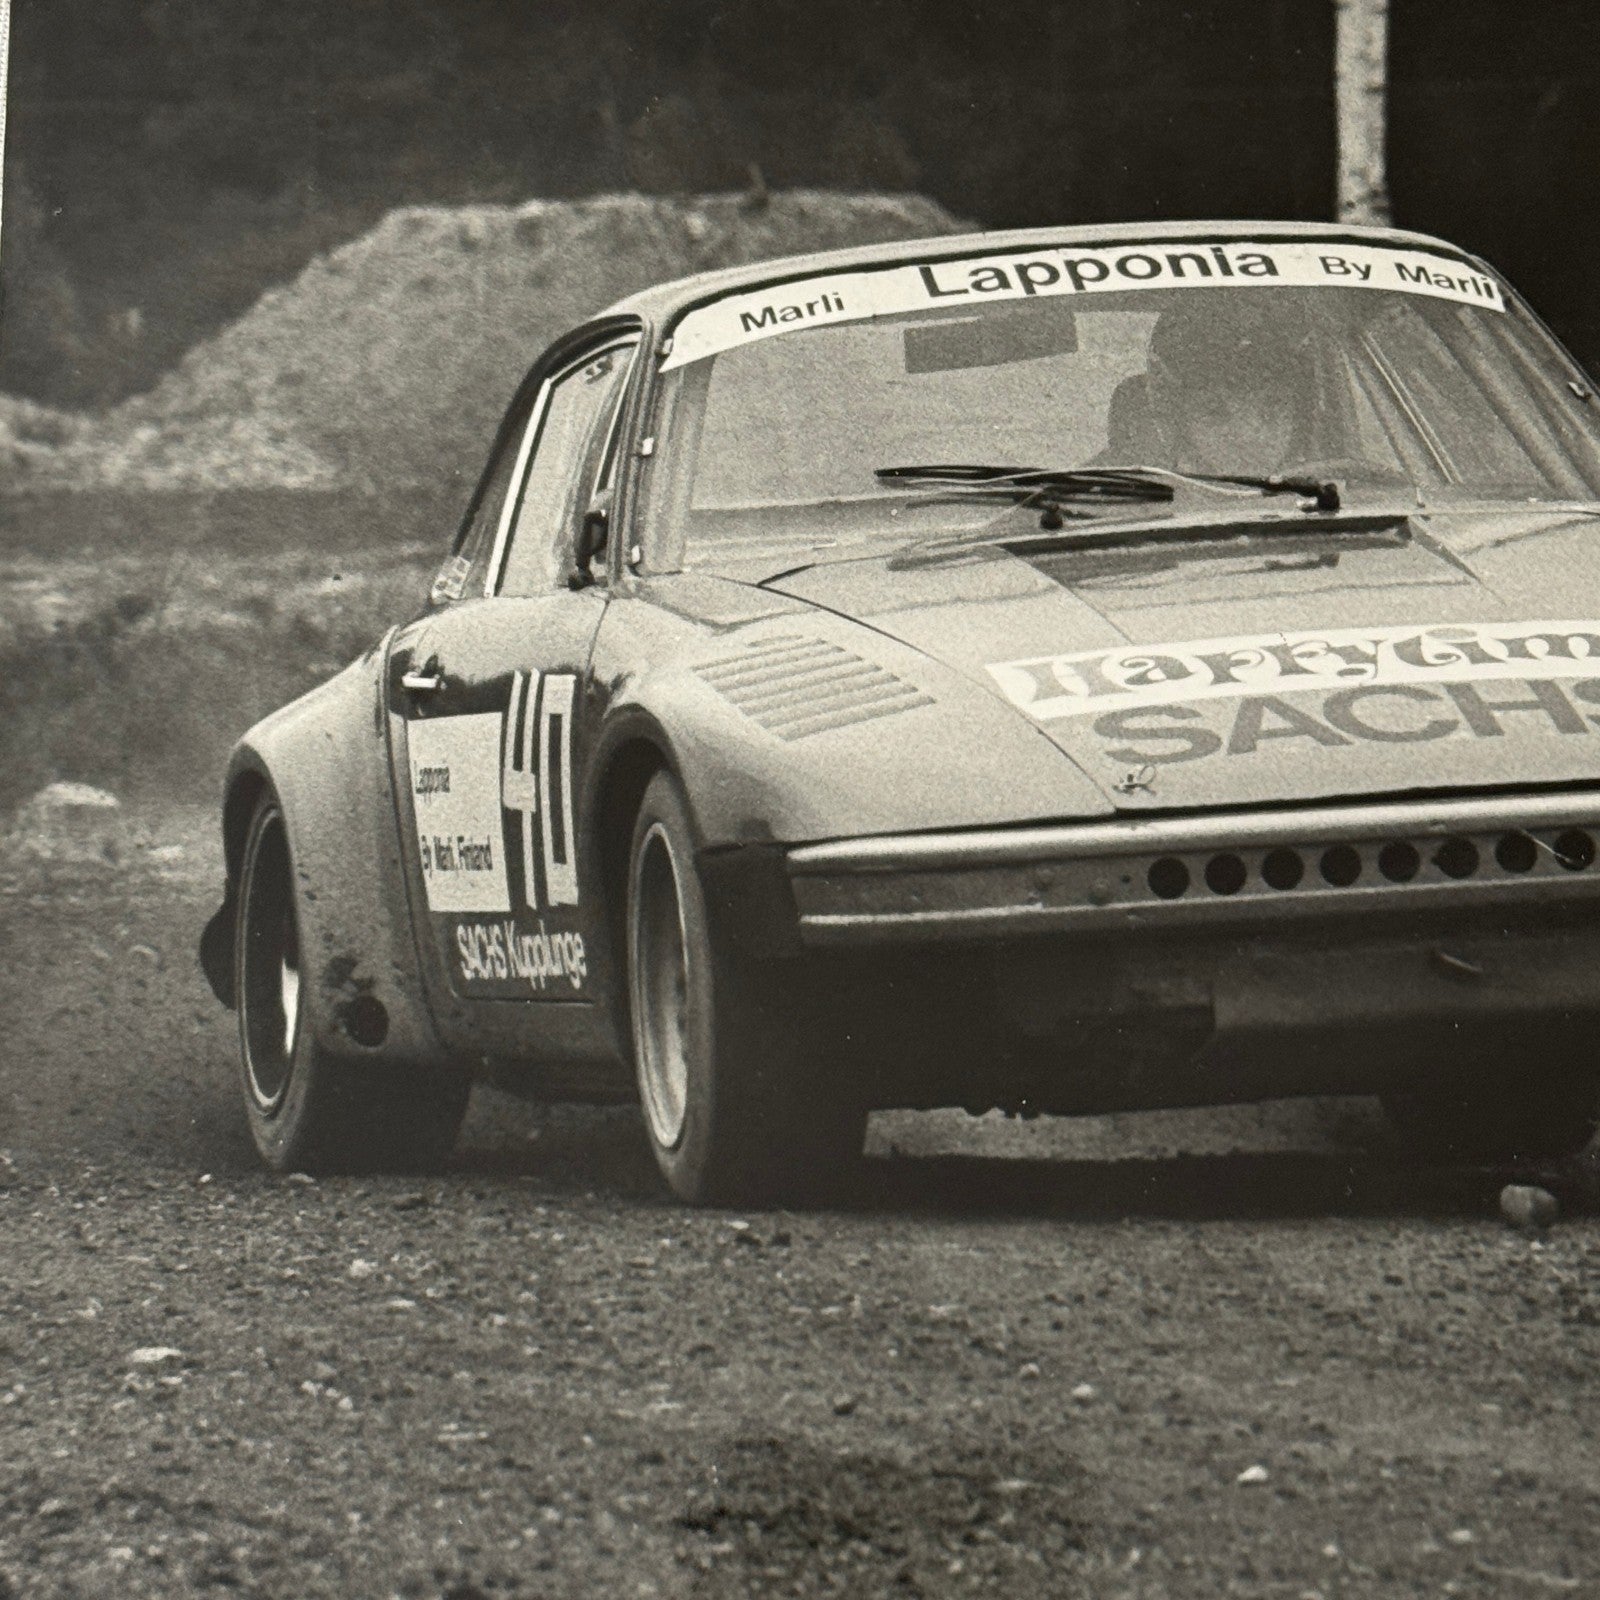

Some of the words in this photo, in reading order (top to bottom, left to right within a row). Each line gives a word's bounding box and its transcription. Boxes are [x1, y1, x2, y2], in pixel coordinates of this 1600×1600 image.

[739, 291, 846, 333] Marli
[918, 245, 1280, 298] Lapponia
[1319, 255, 1373, 281] By
[1394, 261, 1497, 300] Marli
[456, 923, 508, 981] SACHS
